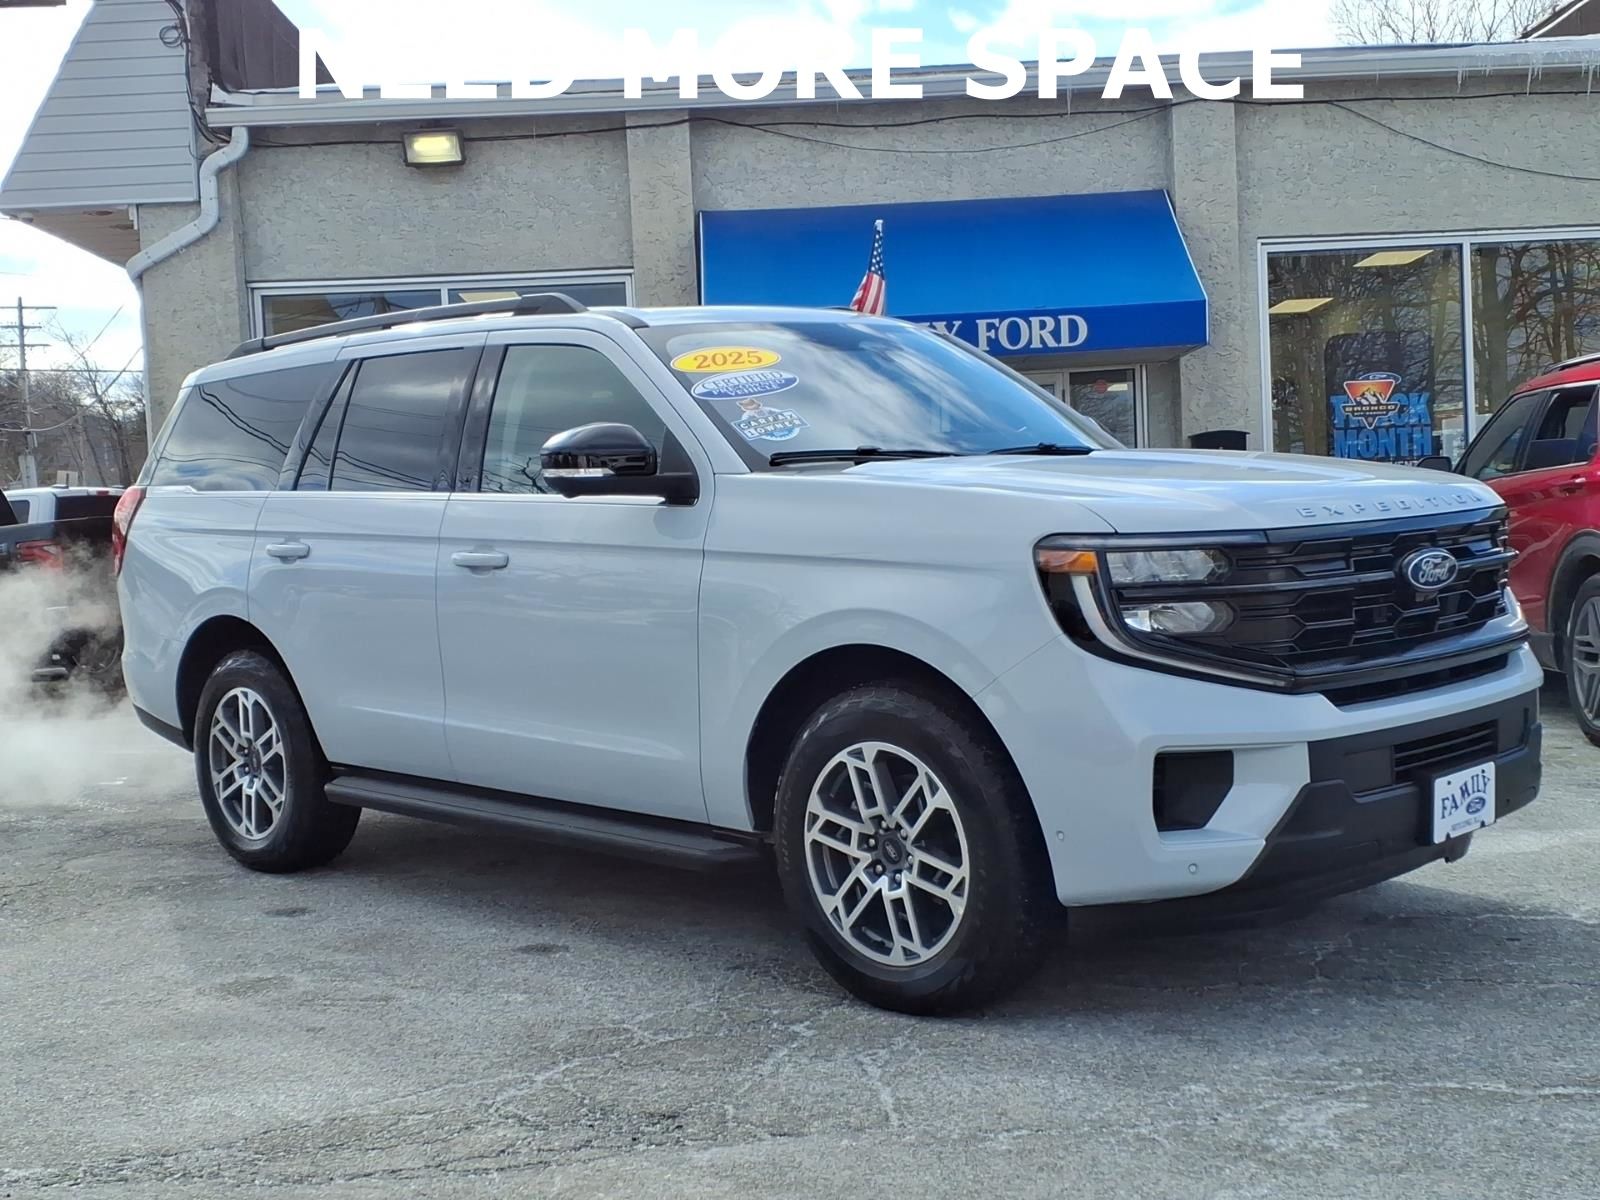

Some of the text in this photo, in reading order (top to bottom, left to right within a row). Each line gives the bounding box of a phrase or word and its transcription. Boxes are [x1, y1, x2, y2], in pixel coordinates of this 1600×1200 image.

[976, 315, 1088, 351] FORD
[693, 351, 763, 369] 2025
[1330, 393, 1430, 428] TCK
[1333, 427, 1432, 459] MONTH
[1297, 492, 1482, 518] EXPEDITION
[1419, 557, 1450, 583] Ford
[1441, 774, 1491, 819] FAMILY
